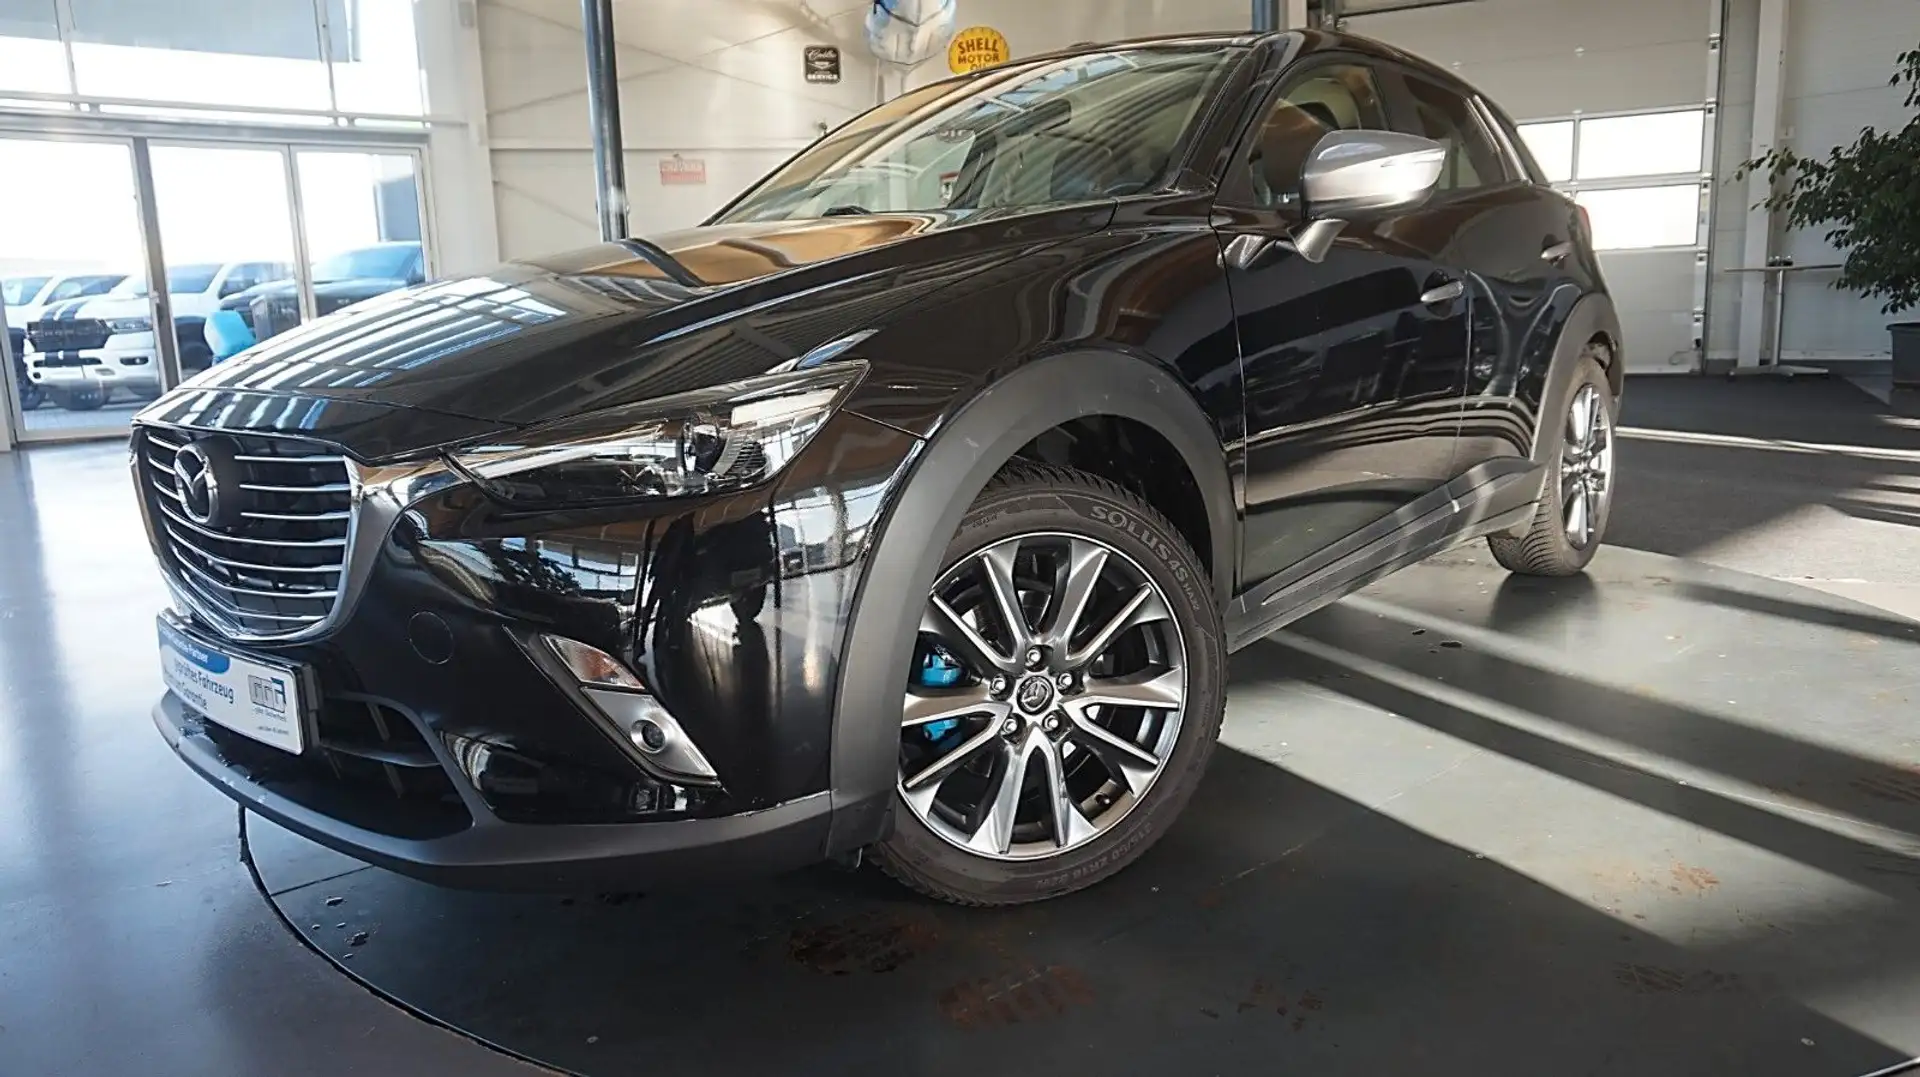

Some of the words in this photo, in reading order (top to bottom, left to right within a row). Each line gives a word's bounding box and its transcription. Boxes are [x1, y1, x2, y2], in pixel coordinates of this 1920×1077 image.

[957, 37, 999, 55] SHELL
[957, 53, 1000, 65] MOTOR
[1090, 505, 1171, 561] SOLUS
[198, 670, 234, 705] Fahrzeug
